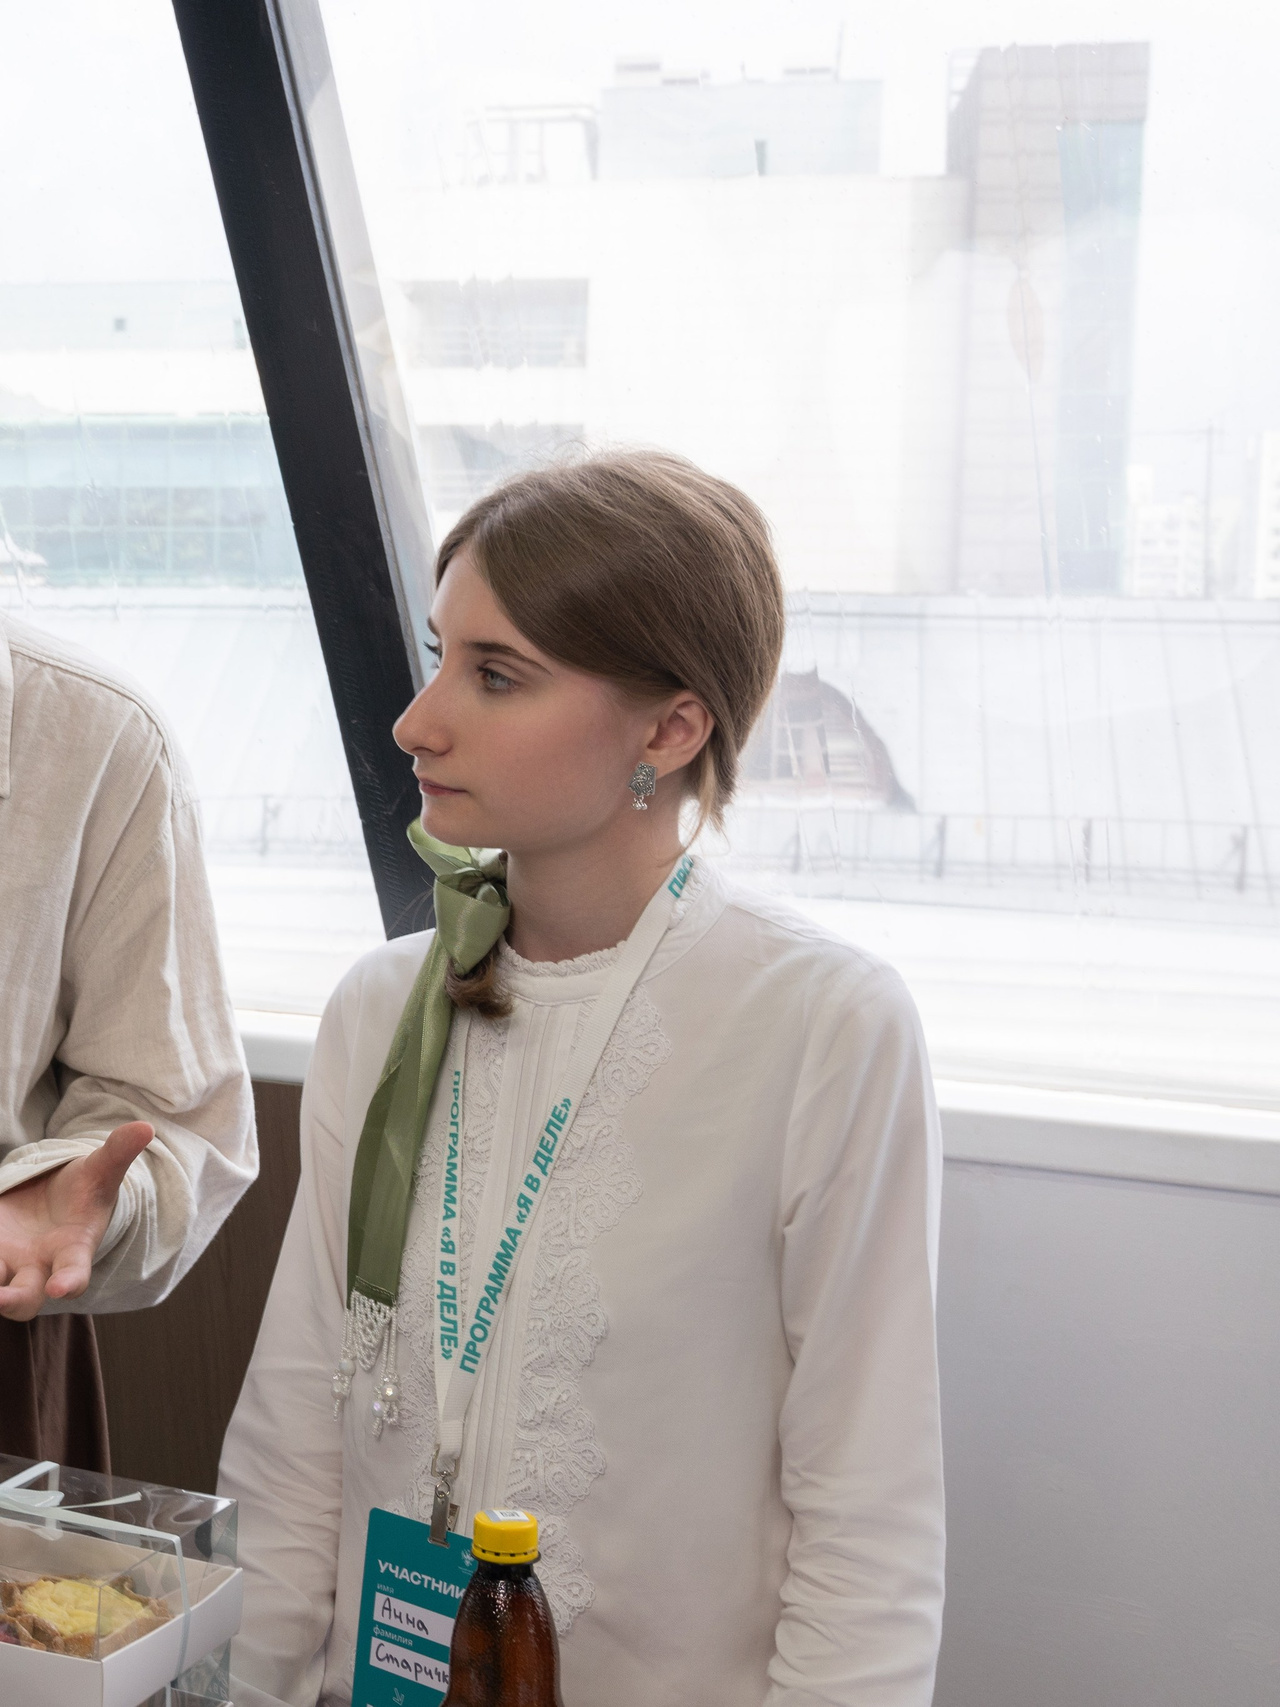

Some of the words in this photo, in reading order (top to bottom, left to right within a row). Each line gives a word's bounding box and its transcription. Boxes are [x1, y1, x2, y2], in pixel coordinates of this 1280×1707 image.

[443, 1070, 461, 1222] ПРОГРАММА
[533, 1097, 572, 1177] ДЕЛЕ»
[524, 1173, 541, 1194] В
[516, 1192, 534, 1224] «Я
[441, 1226, 456, 1256] «Я
[439, 1260, 456, 1276] В
[459, 1226, 522, 1374] ПРОГРАММА
[437, 1279, 459, 1361] ДЕЛЕ»
[376, 1582, 395, 1595] имя
[380, 1596, 429, 1636] Анна
[372, 1624, 414, 1647] фамилия
